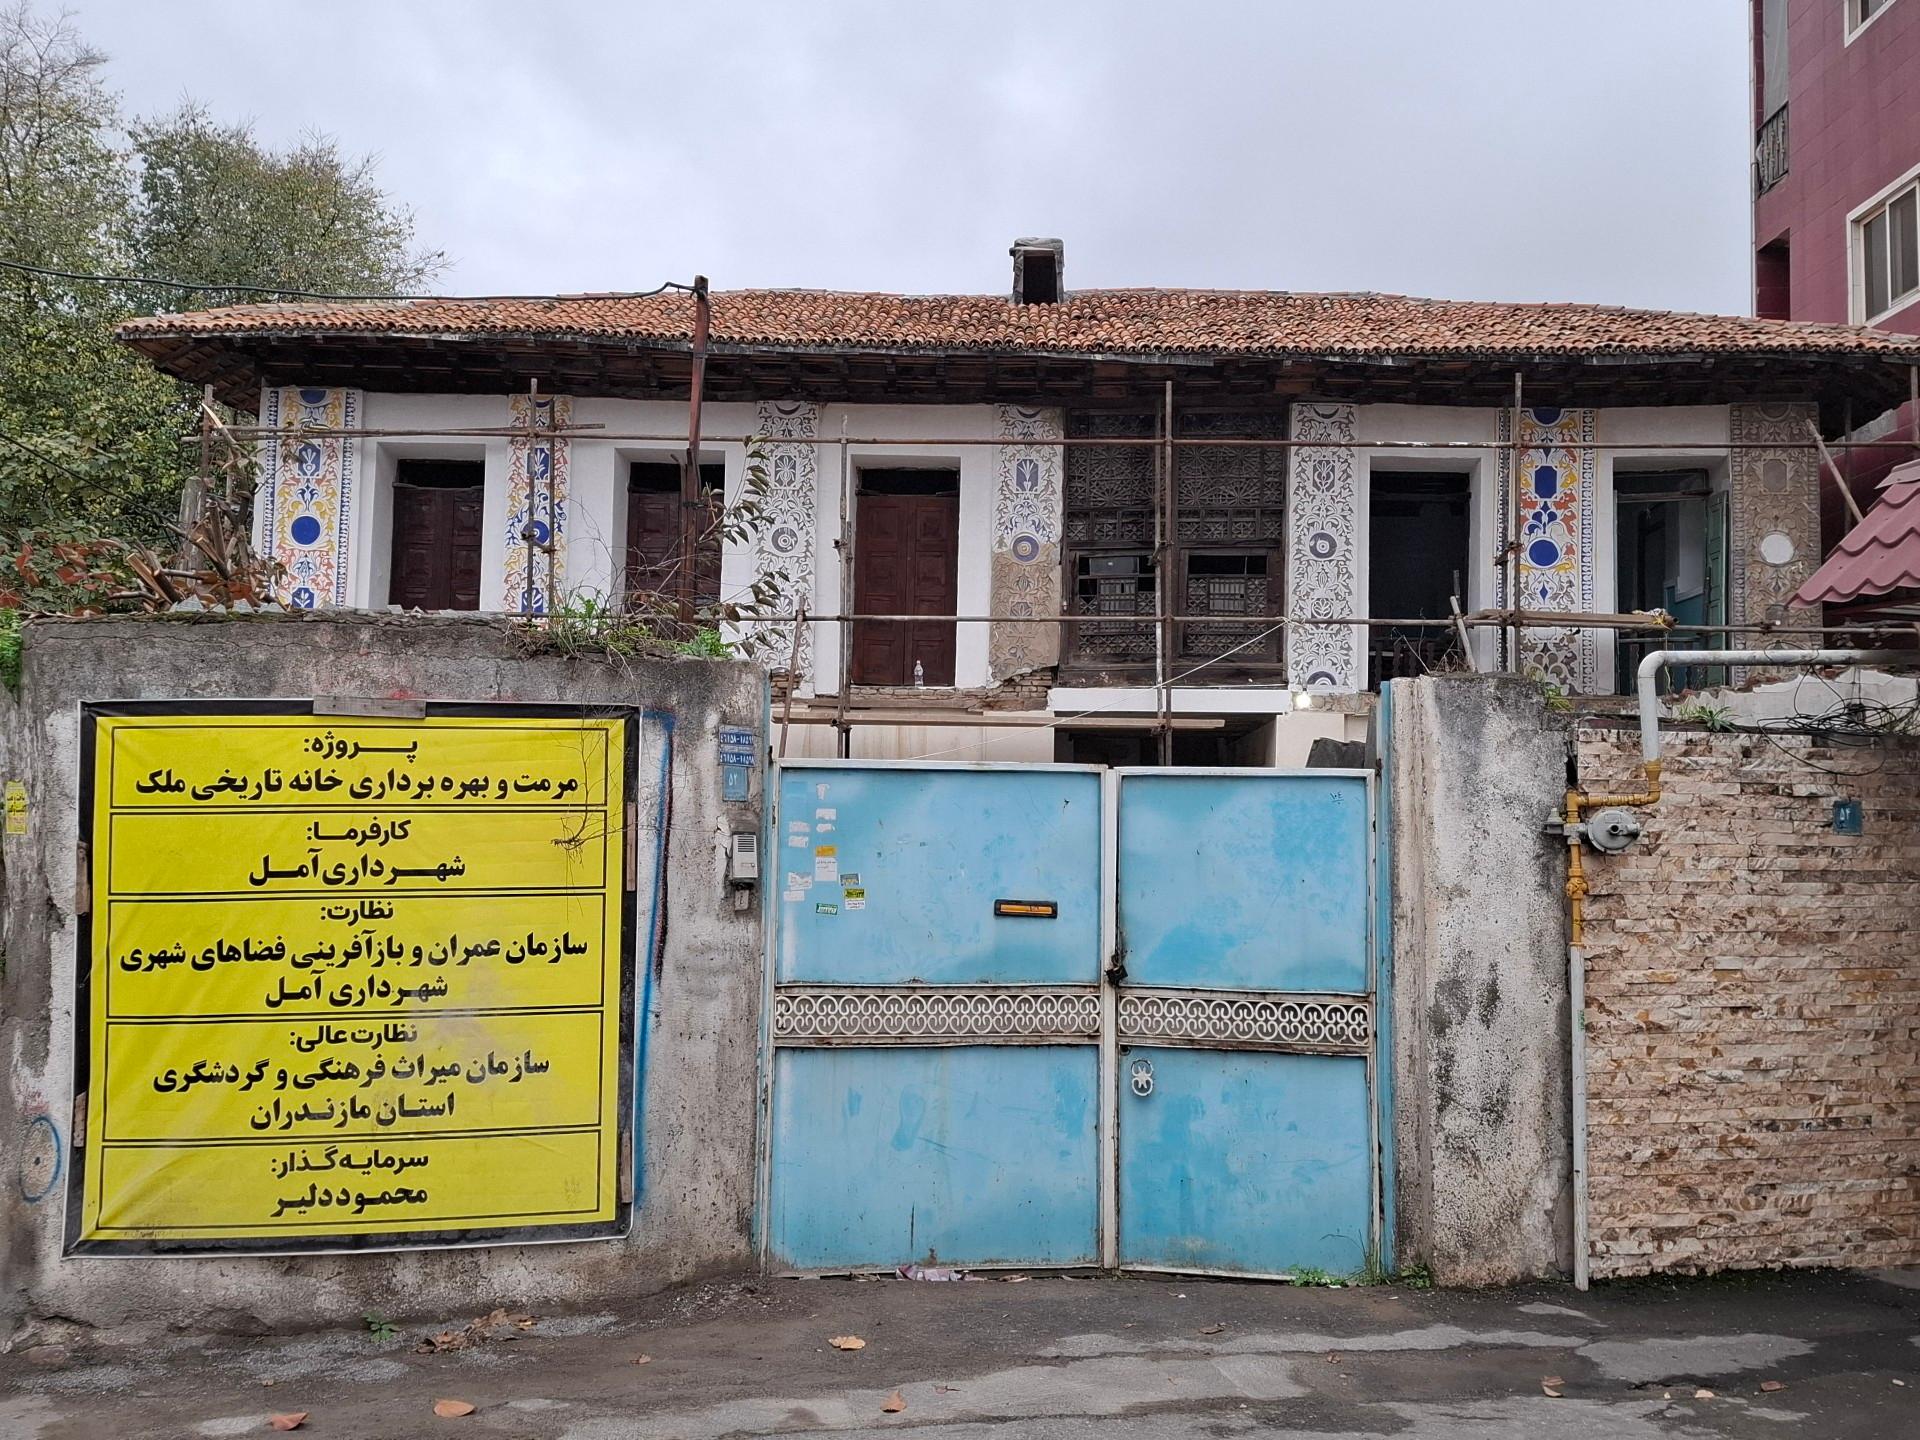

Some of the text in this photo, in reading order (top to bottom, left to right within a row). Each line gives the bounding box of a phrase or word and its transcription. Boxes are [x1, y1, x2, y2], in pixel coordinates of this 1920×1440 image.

[304, 731, 417, 764] پروژه:
[136, 768, 579, 800] مرمت و بهره برداری خانه تاریخی ملک
[307, 817, 411, 847] کارفرما:
[249, 848, 466, 887] شهرداری آمل
[321, 900, 394, 927] نظارت:
[121, 930, 588, 973] سازمان عمران و بازآفرینی فضاهای شهری
[266, 970, 448, 1009] شهرداری آمل
[290, 1024, 418, 1053] نظارت عالی:
[154, 1050, 550, 1093] سازمان میراث فرهنگی و گردشگری
[251, 1092, 455, 1130] استان مازندران
